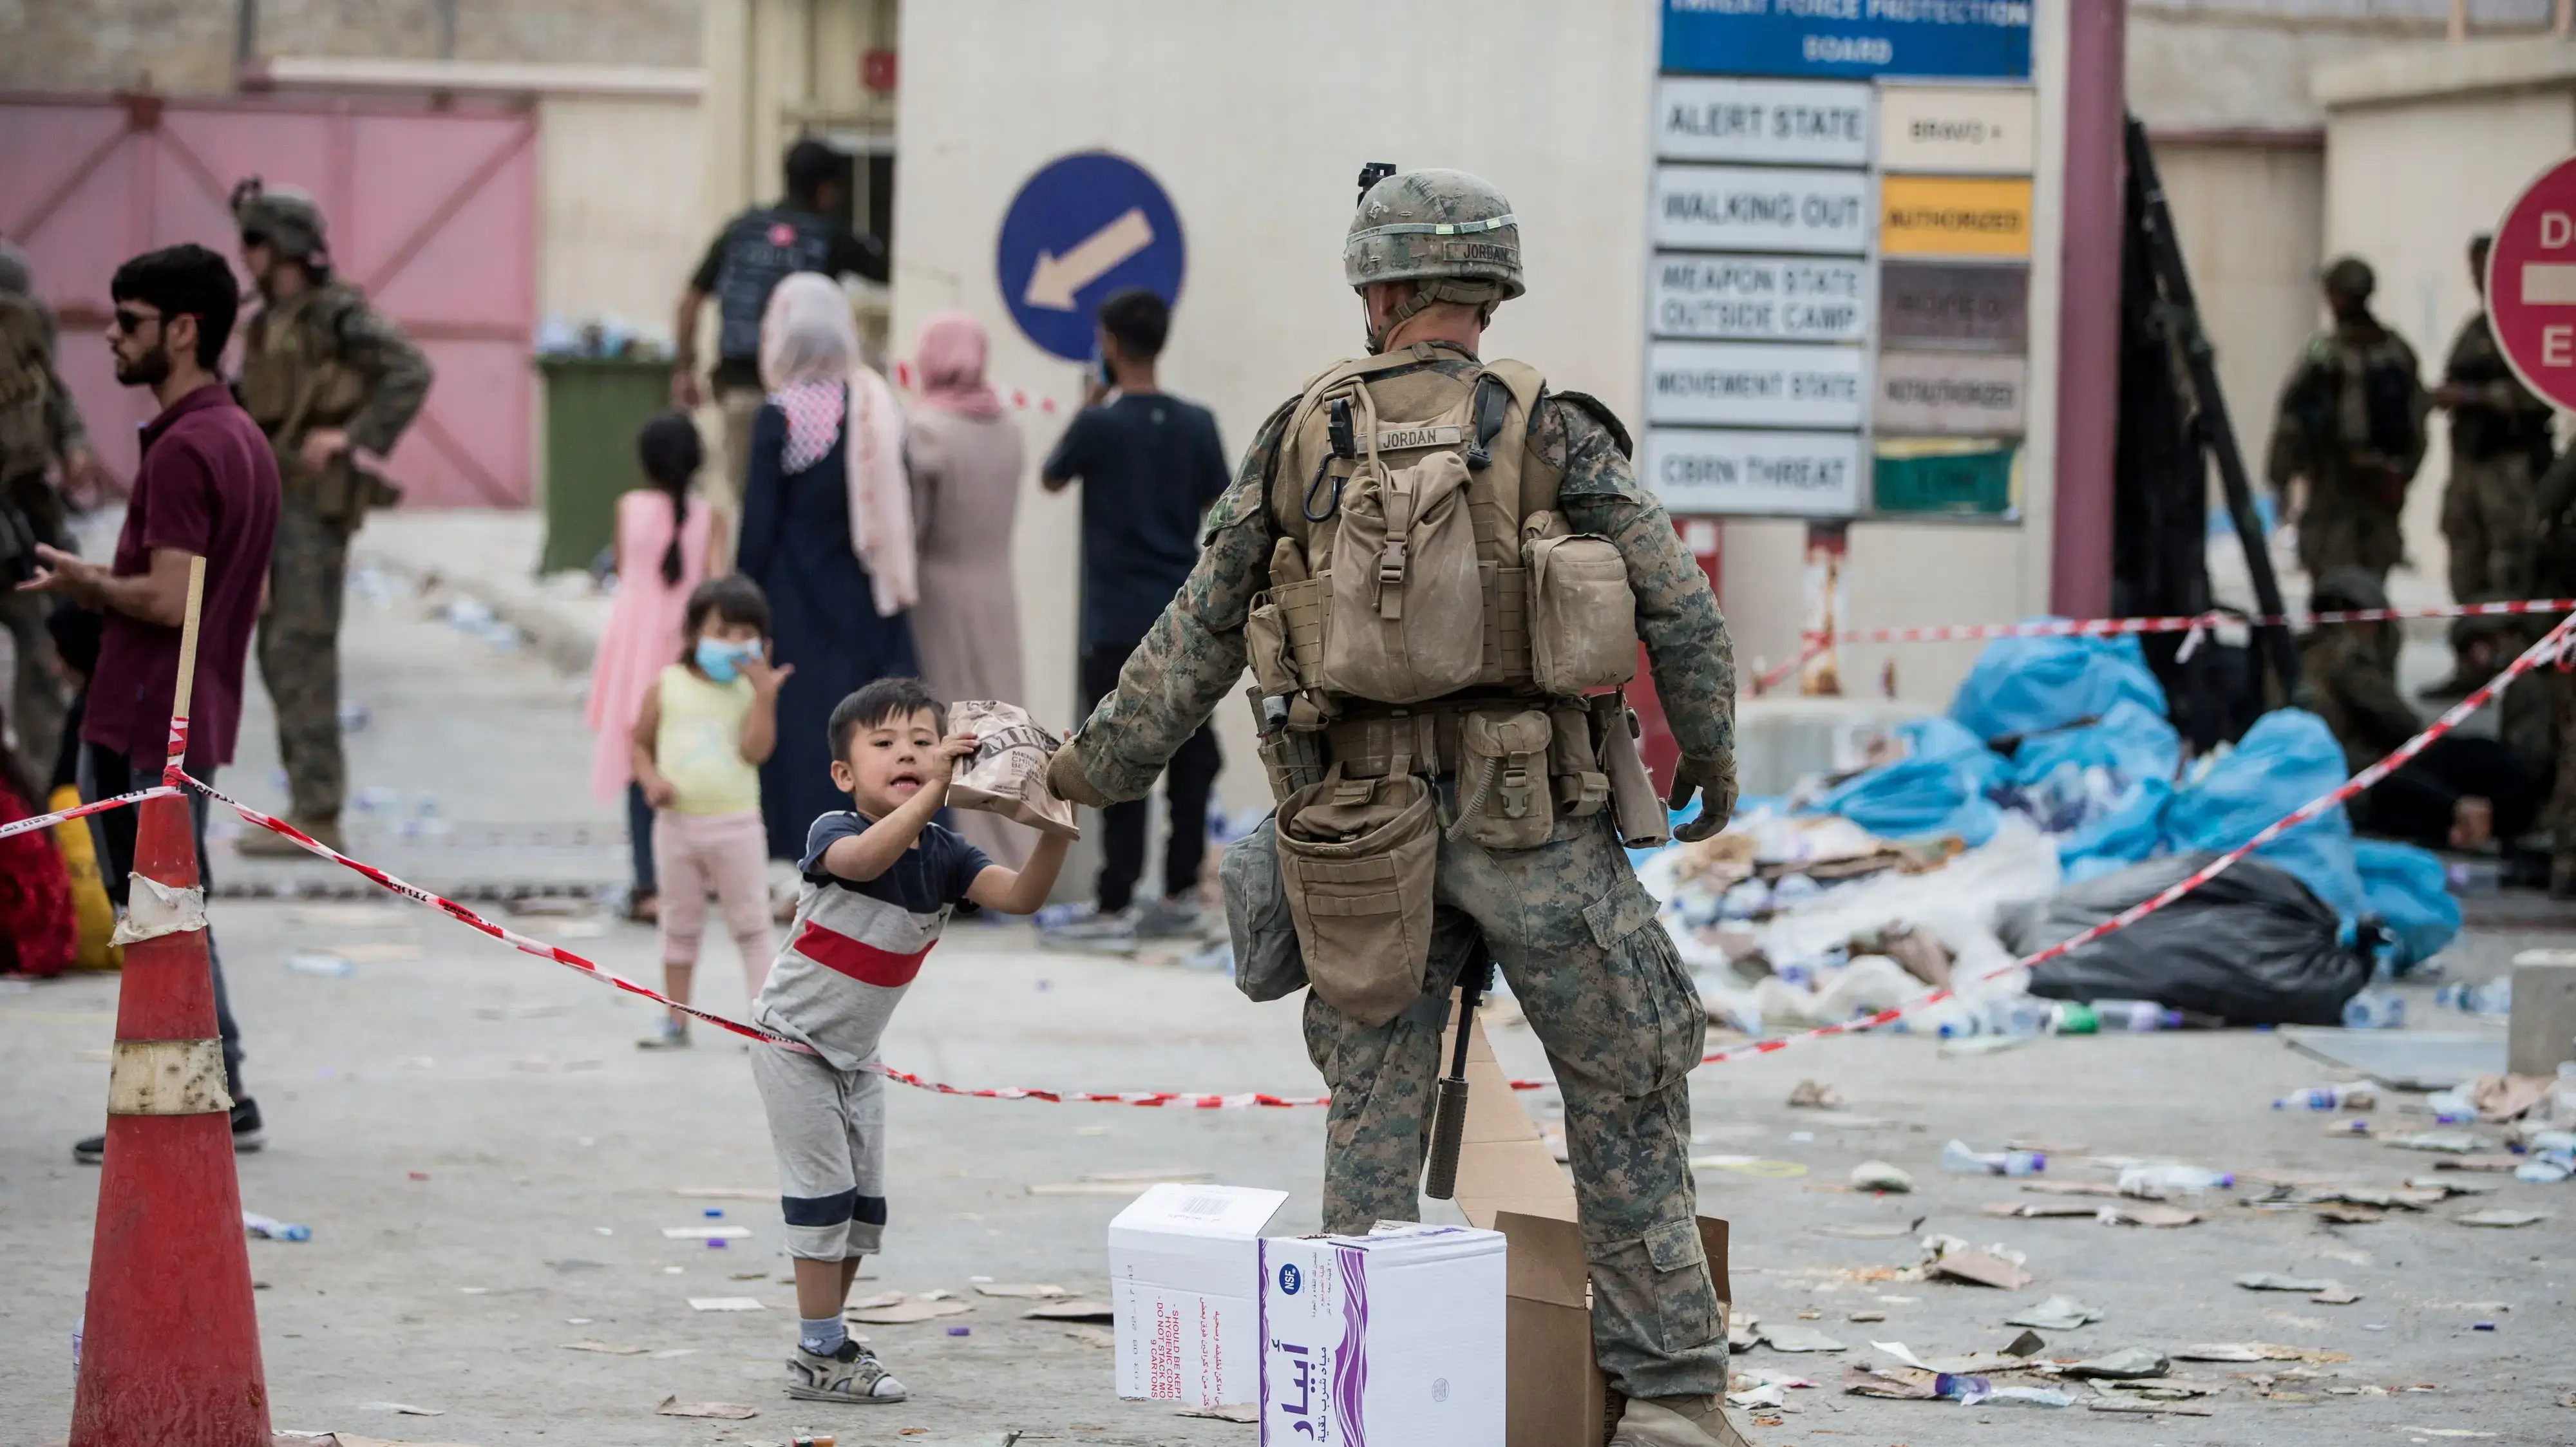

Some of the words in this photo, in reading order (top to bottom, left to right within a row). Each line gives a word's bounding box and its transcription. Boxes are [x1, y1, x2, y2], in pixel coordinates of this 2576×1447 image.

[1775, 0, 1859, 21] FORCE
[1868, 0, 2029, 26] PROTECTION
[1803, 37, 1892, 63] BOARD
[1668, 106, 1765, 137] ALERT
[1773, 108, 1862, 140] STATE
[1909, 119, 1984, 142] BRAVO
[1663, 194, 1794, 227] WALKING
[1803, 196, 1860, 229] OUT
[2541, 210, 2576, 249] D
[1464, 243, 1508, 263] JORDAN
[1661, 266, 1775, 293] WEAPON
[1783, 269, 1857, 296] STATE
[1660, 300, 1775, 329] OUTSIDE
[1783, 304, 1857, 331] CAMP
[1656, 370, 1782, 399] MOVEMENT
[1790, 373, 1857, 401] STATE
[1383, 428, 1437, 449] JORDAN
[1661, 457, 1736, 486] CBRN
[1745, 458, 1846, 489] THREAT
[1284, 1270, 1294, 1289] NSF
[1157, 1302, 1164, 1318] DO
[1172, 1310, 1180, 1353] SHOULD
[1173, 1356, 1180, 1370] BE
[1319, 1347, 1330, 1376] مياه
[1173, 1373, 1182, 1401] KEPT
[1201, 1376, 1208, 1389] من
[1215, 1371, 1224, 1395] أماكن
[1271, 1339, 1316, 1442] أبيار
[1318, 1378, 1330, 1412] شرب
[1318, 1415, 1329, 1443] نقية
[1602, 1432, 1614, 1447] UN
